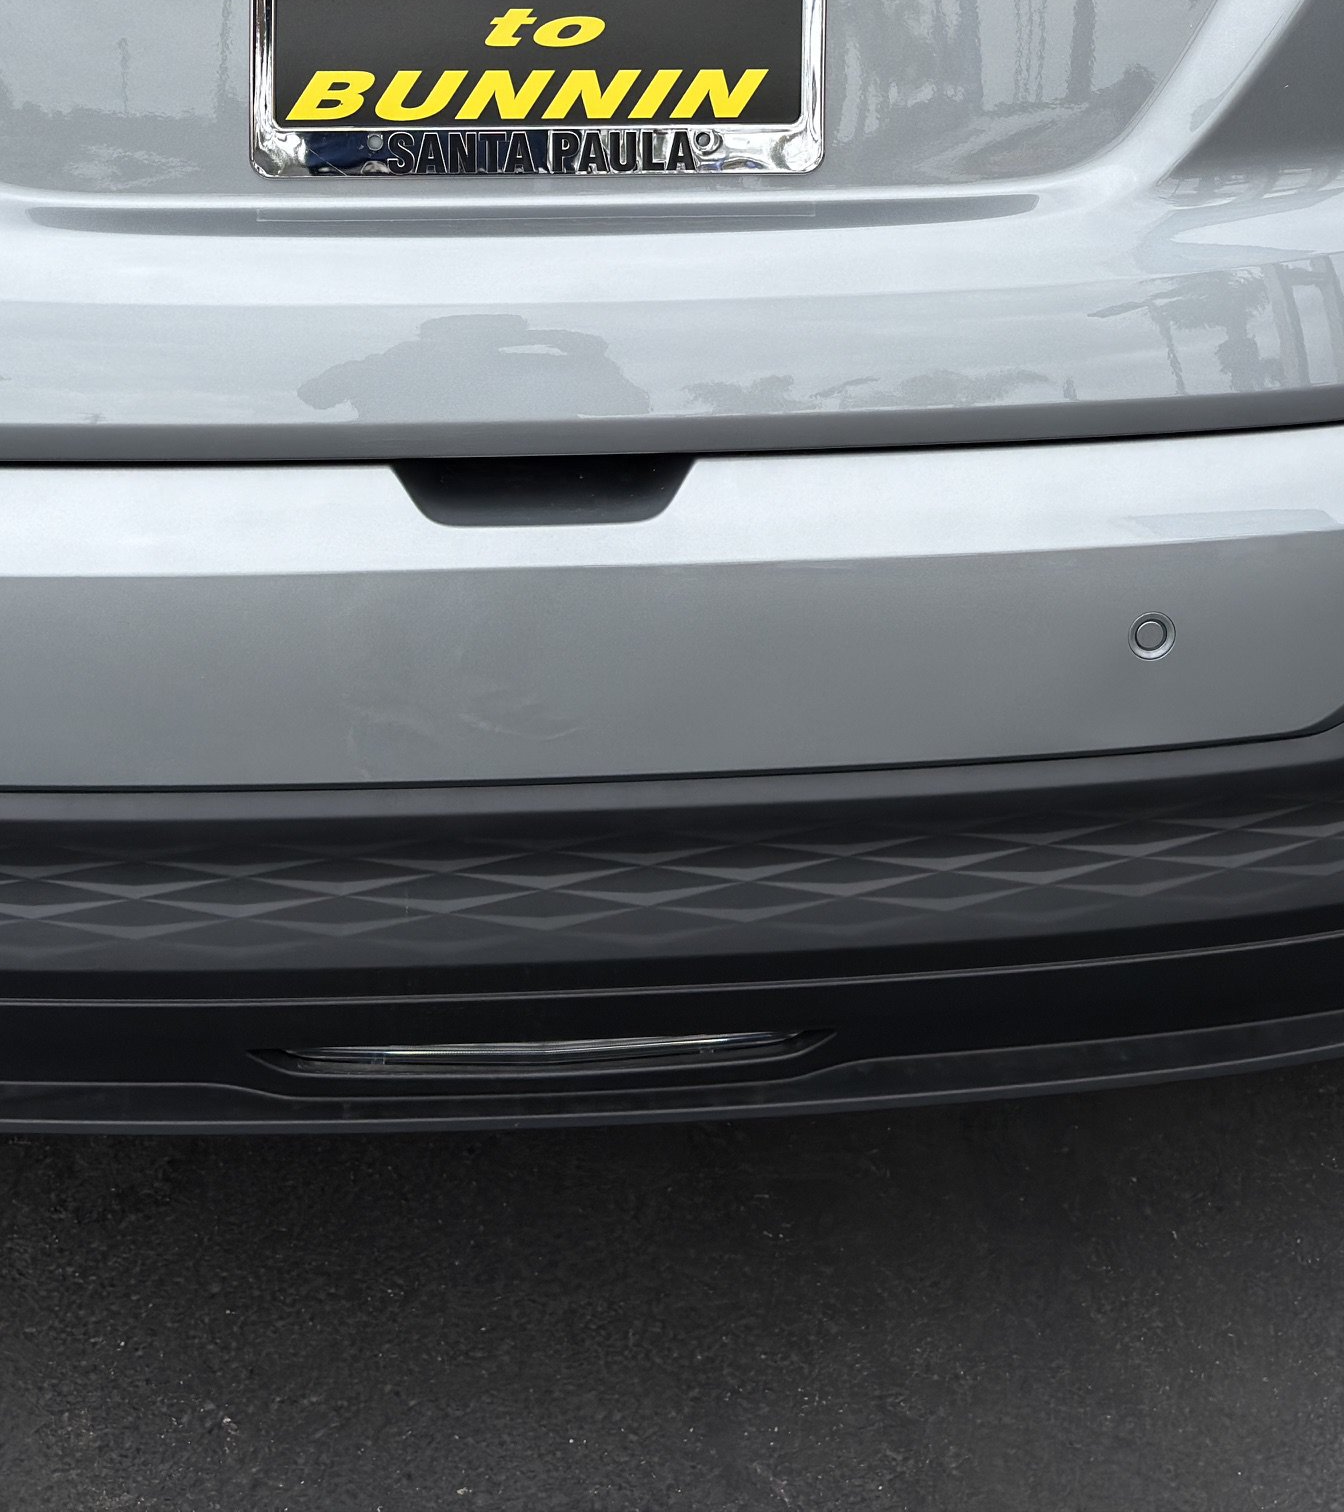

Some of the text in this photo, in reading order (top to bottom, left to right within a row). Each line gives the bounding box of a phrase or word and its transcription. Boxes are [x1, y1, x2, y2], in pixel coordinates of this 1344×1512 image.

[484, 8, 606, 47] to
[285, 69, 769, 121] BUNNIN
[387, 130, 697, 175] SANTA PAULA
